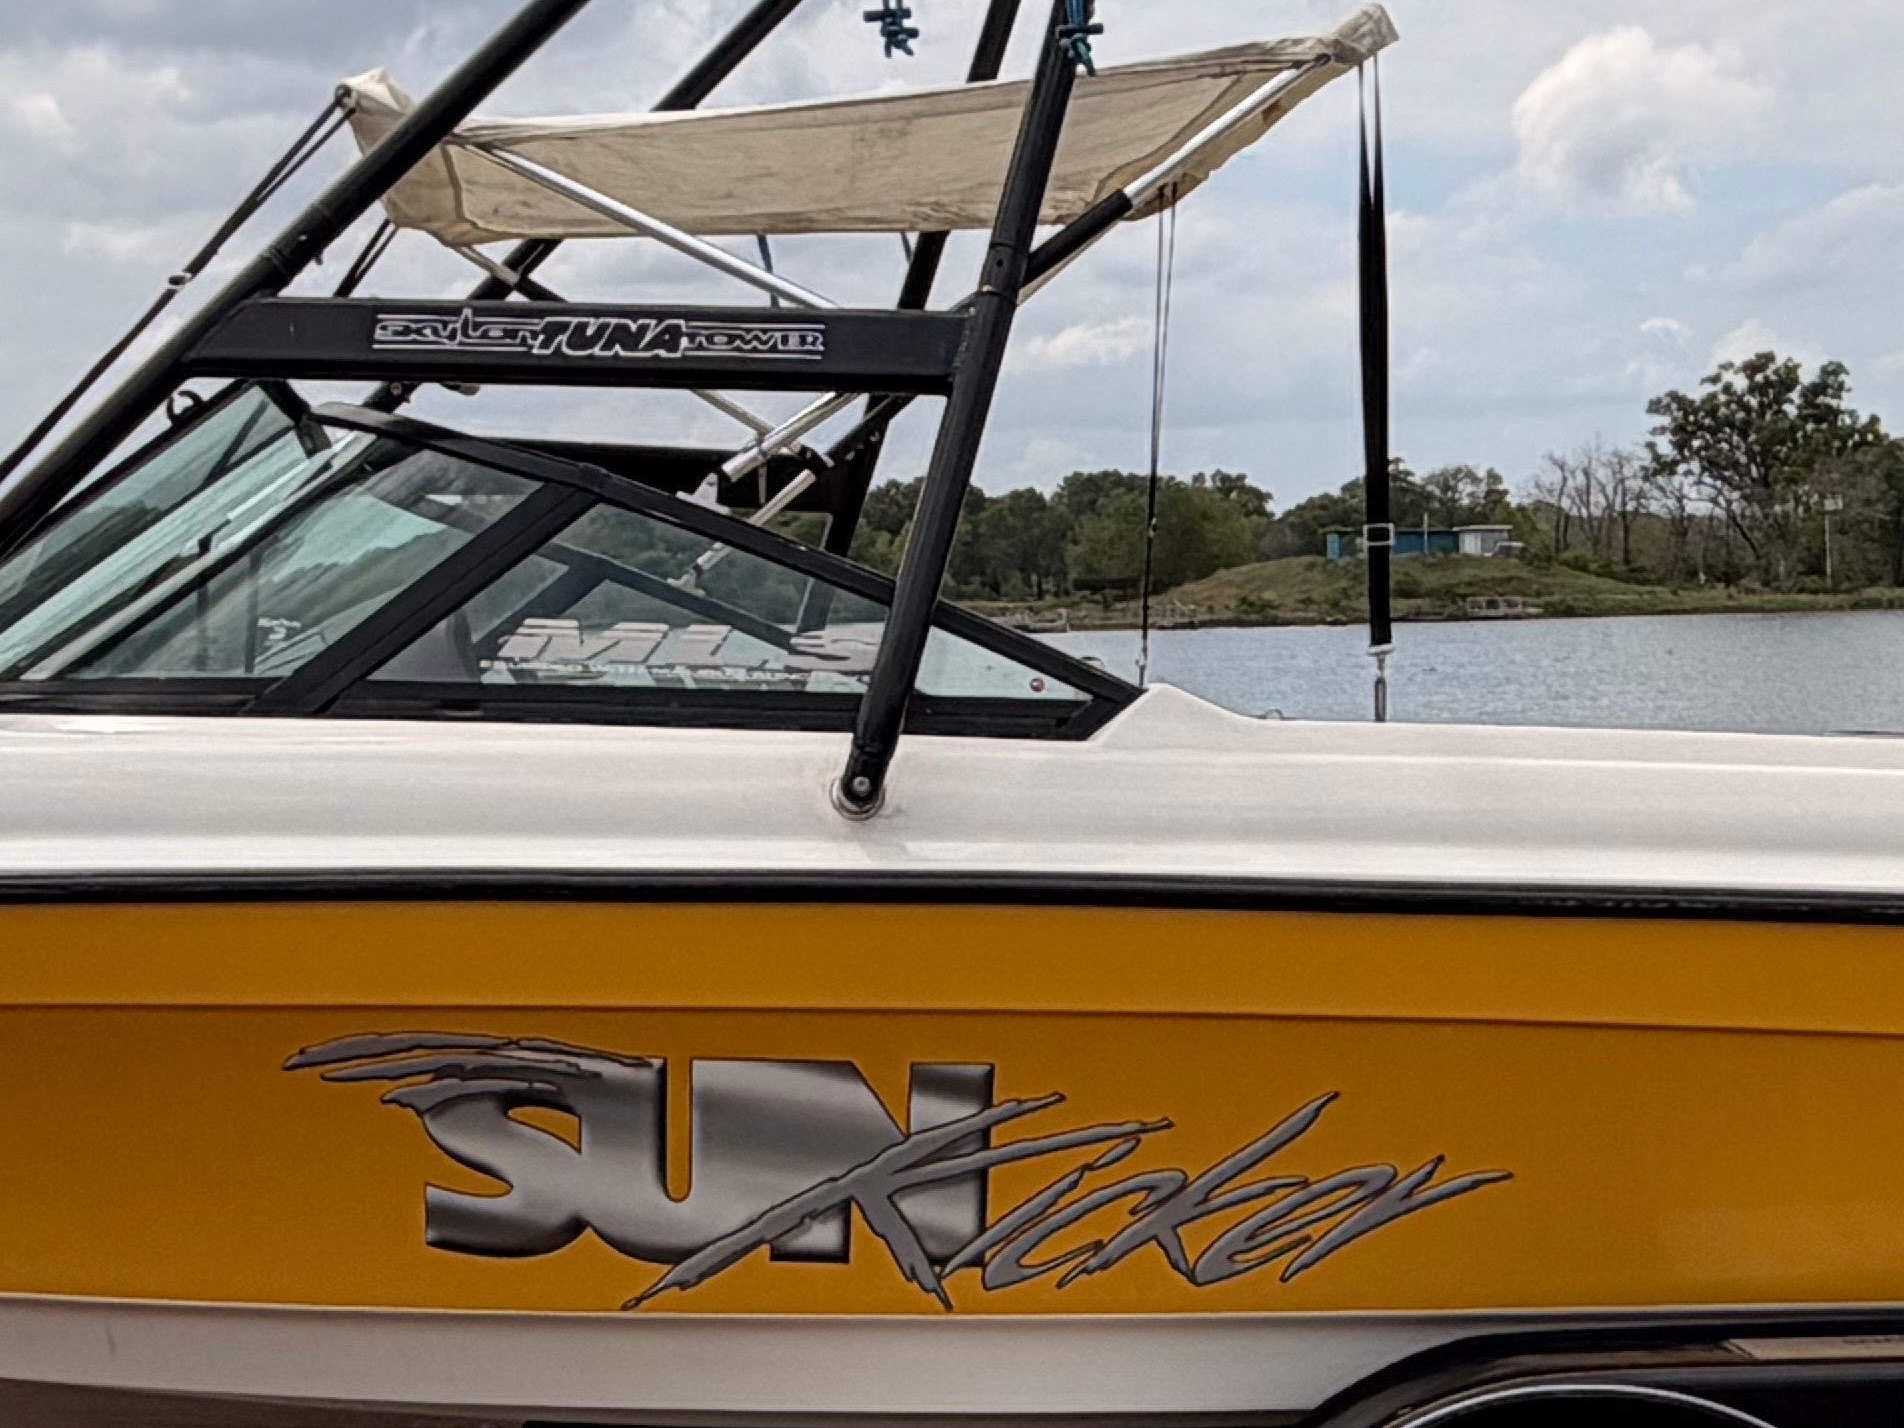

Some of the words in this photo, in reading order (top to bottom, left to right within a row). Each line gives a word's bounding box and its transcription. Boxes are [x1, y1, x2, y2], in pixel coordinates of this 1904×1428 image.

[533, 317, 686, 357] TUNA
[682, 330, 826, 351] TOWER
[284, 1031, 996, 1265] SUN
[619, 1090, 1513, 1312] Kicker
